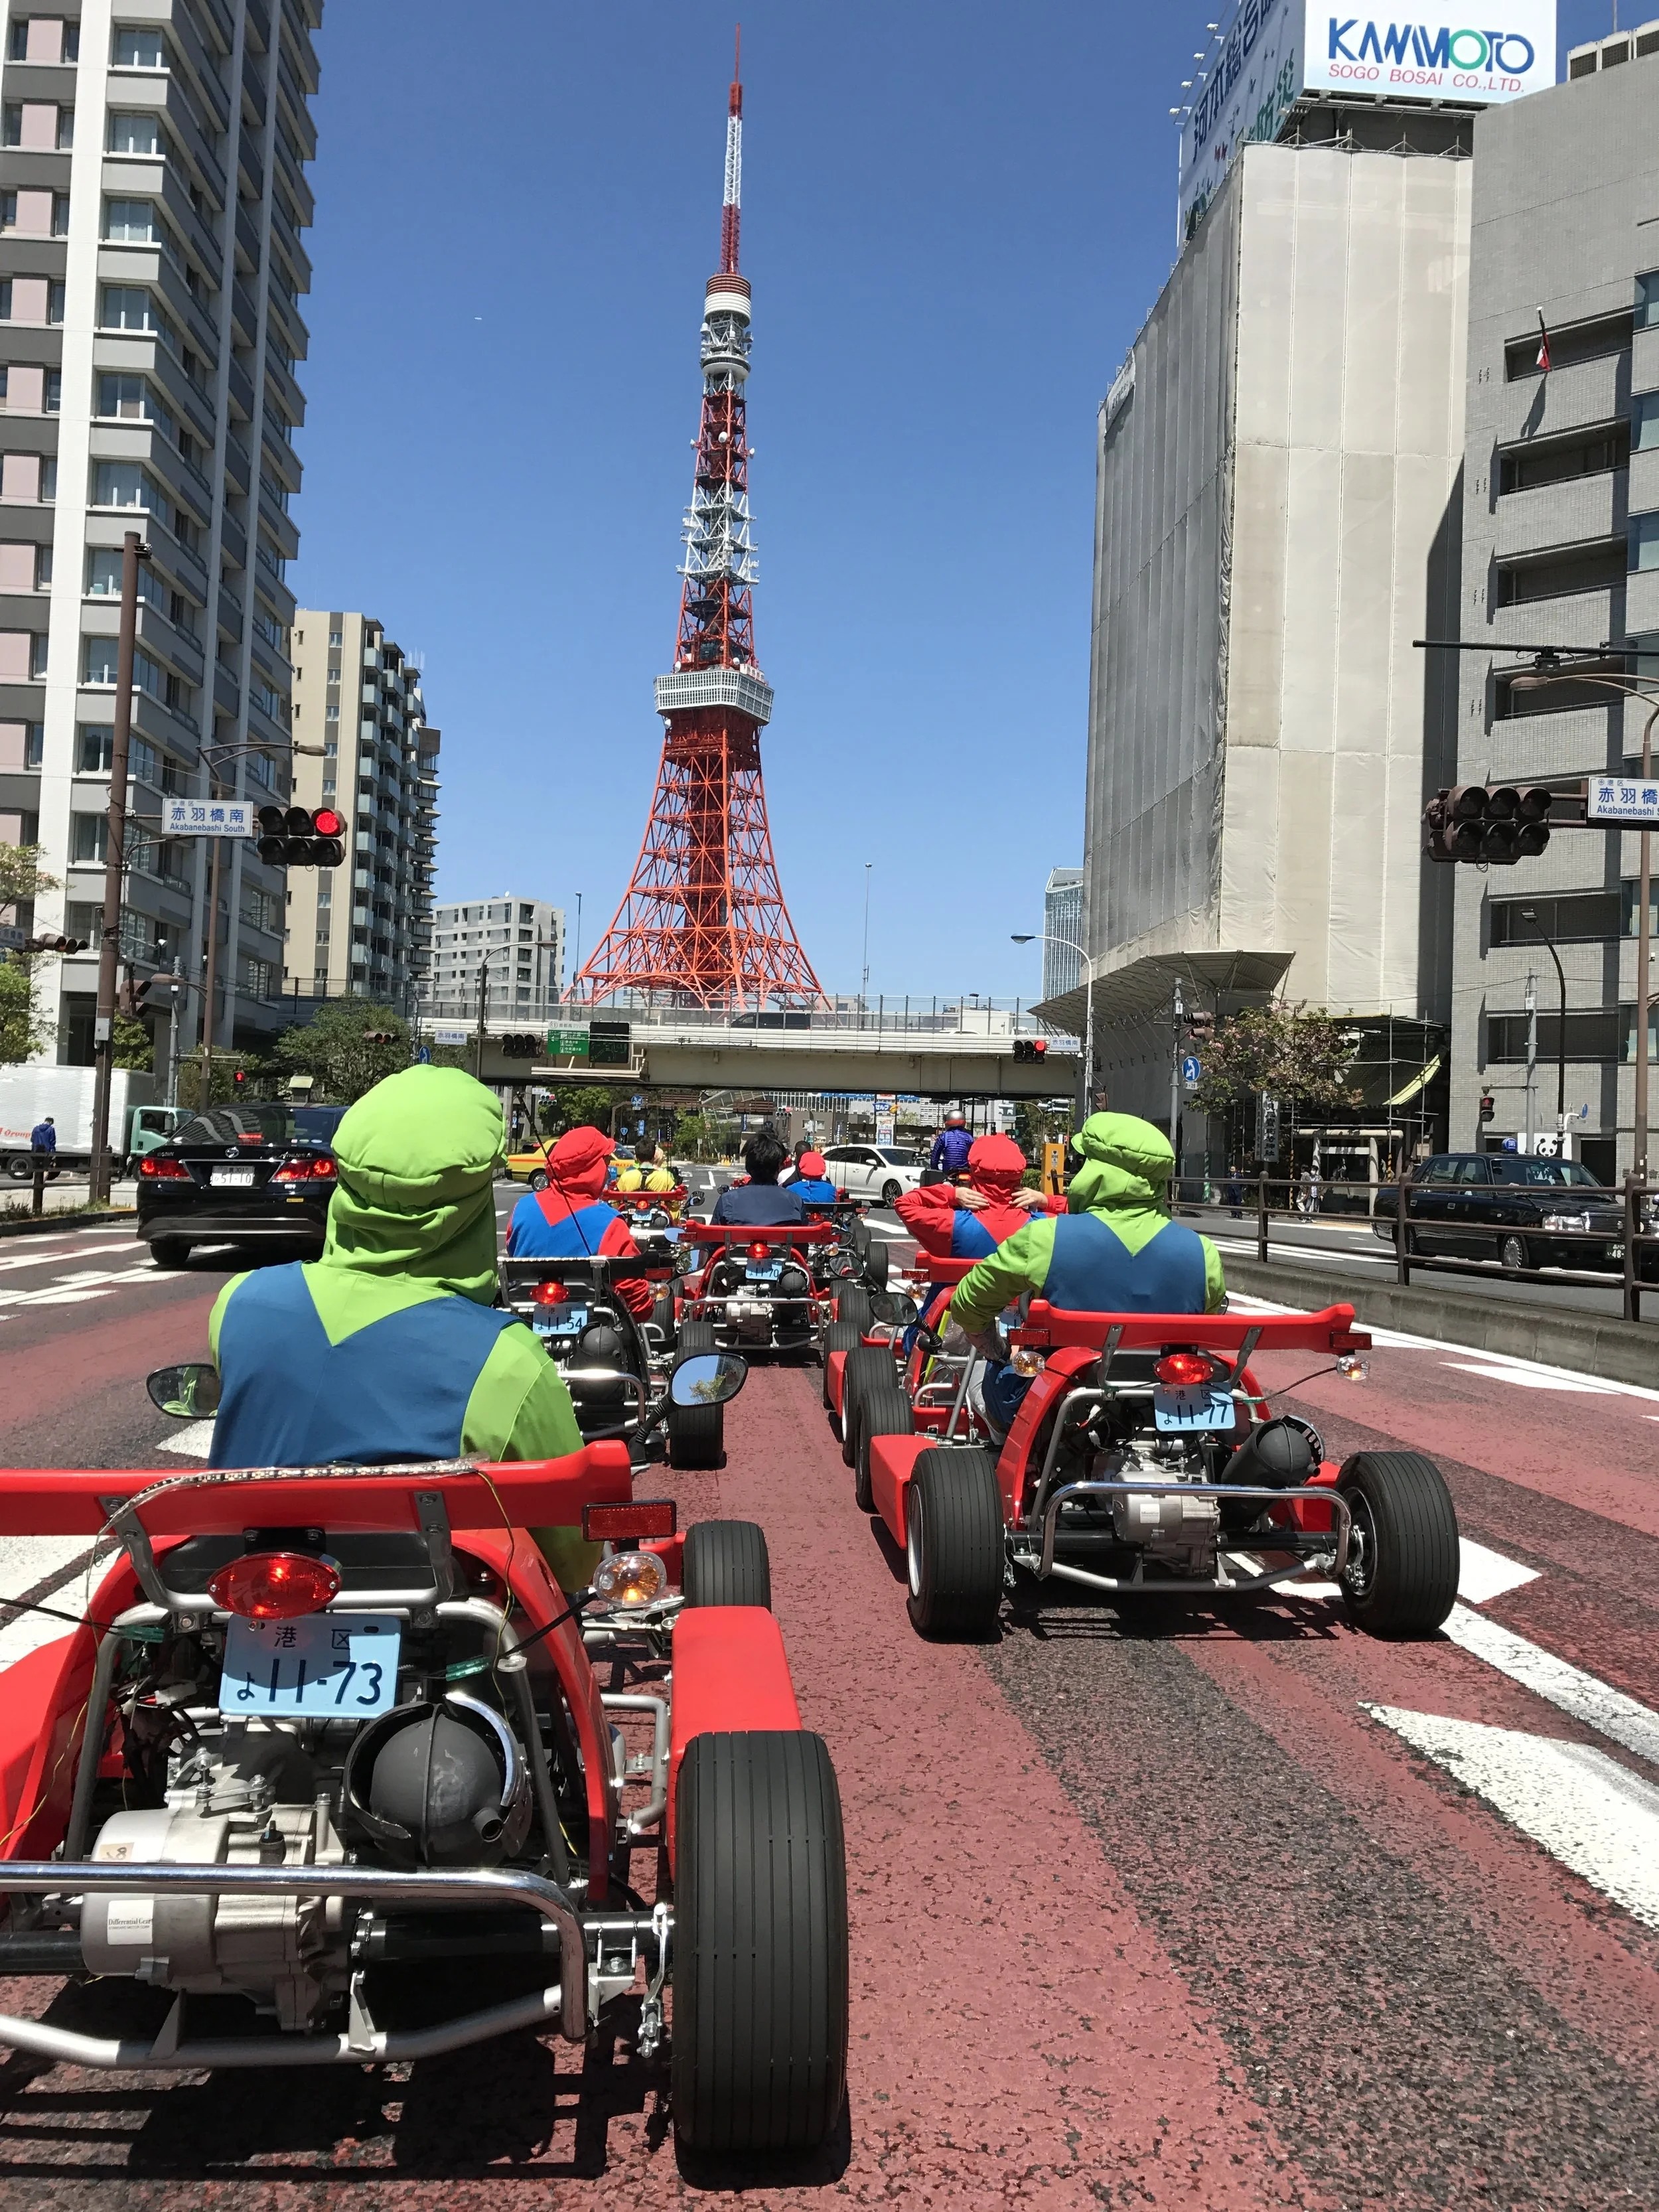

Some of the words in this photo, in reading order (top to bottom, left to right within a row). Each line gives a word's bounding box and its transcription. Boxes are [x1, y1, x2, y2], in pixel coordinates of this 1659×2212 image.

[1329, 17, 1535, 74] KAWAMOTO
[1329, 64, 1380, 80] SOGO
[1390, 68, 1443, 86] BOSAI
[1452, 74, 1525, 93] CO.,LTD.
[1598, 787, 1658, 804] 赤羽橋
[171, 806, 244, 823] 赤羽橋南
[1597, 805, 1654, 816] Akabanebashi
[170, 822, 222, 832] Akabanebashi
[221, 1173, 252, 1184] 51-10
[1612, 1249, 1624, 1258] 48-
[755, 1267, 779, 1278] 11-70
[547, 1317, 583, 1331] 11-54
[1175, 1389, 1210, 1400] 港区
[1164, 1412, 1173, 1425] よ
[1177, 1404, 1228, 1425] 11-77
[274, 1625, 352, 1651] 港区
[237, 1671, 255, 1701] よ
[268, 1659, 383, 1706] 11-73
